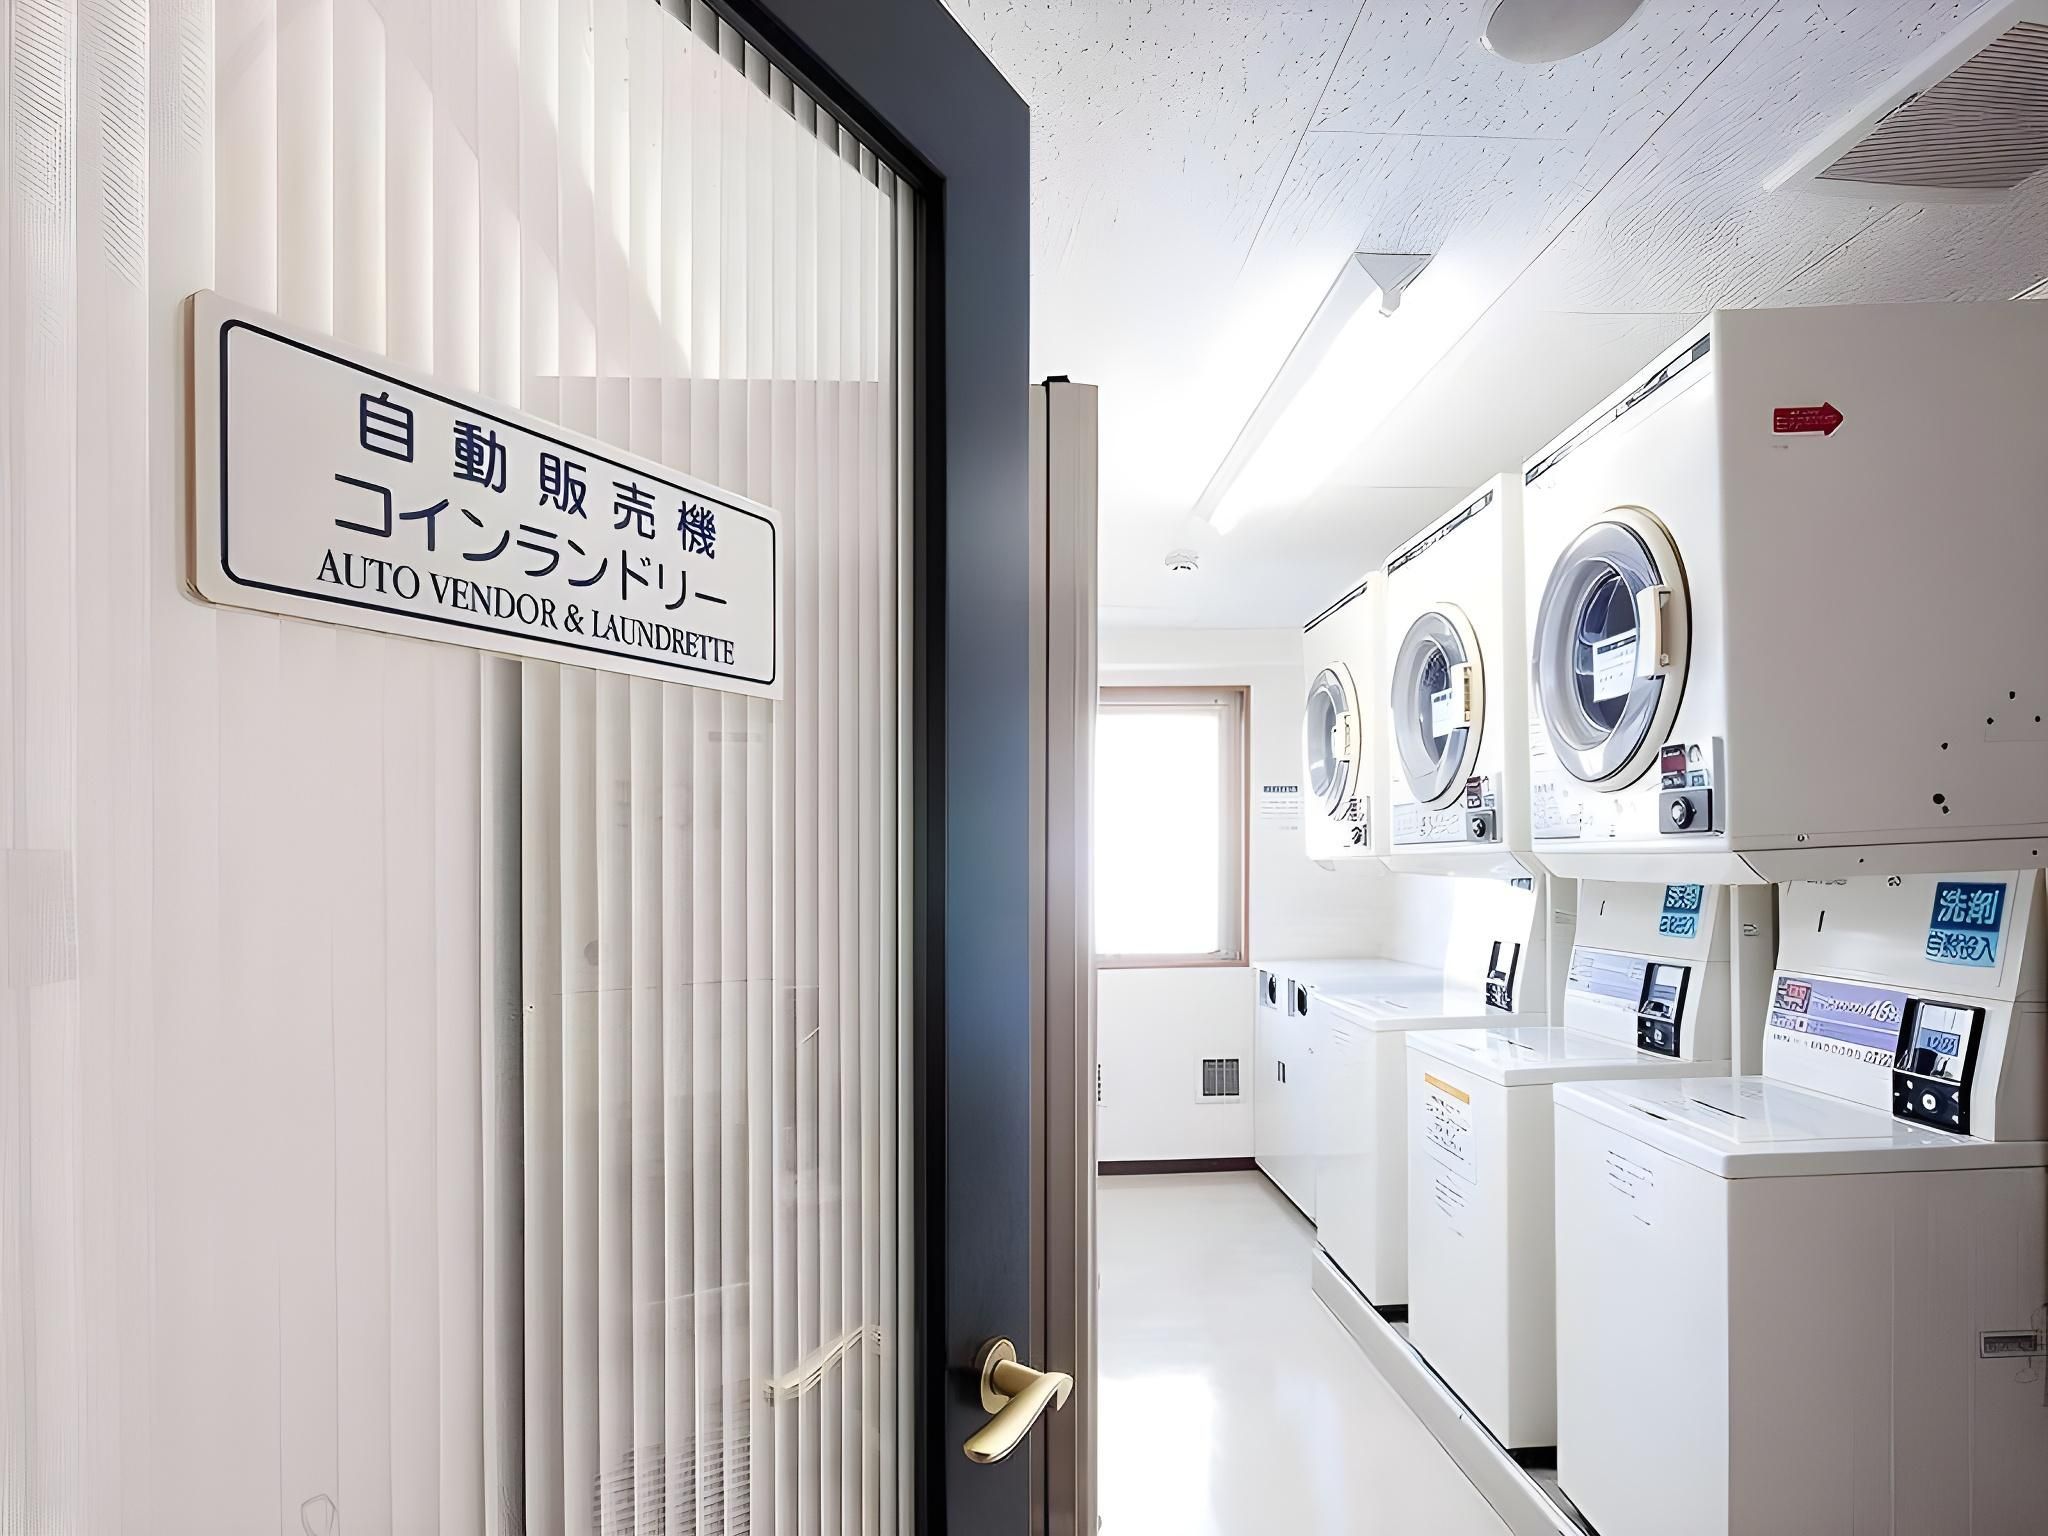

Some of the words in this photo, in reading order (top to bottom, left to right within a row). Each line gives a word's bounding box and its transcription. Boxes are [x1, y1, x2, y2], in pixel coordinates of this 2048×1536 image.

[335, 473, 727, 610] コインランドリー
[360, 391, 716, 559] 自動販売機
[316, 549, 420, 600] AUTO
[429, 571, 558, 630] VENDOR
[564, 604, 585, 635] &
[592, 609, 735, 665] LAUNDRETTE
